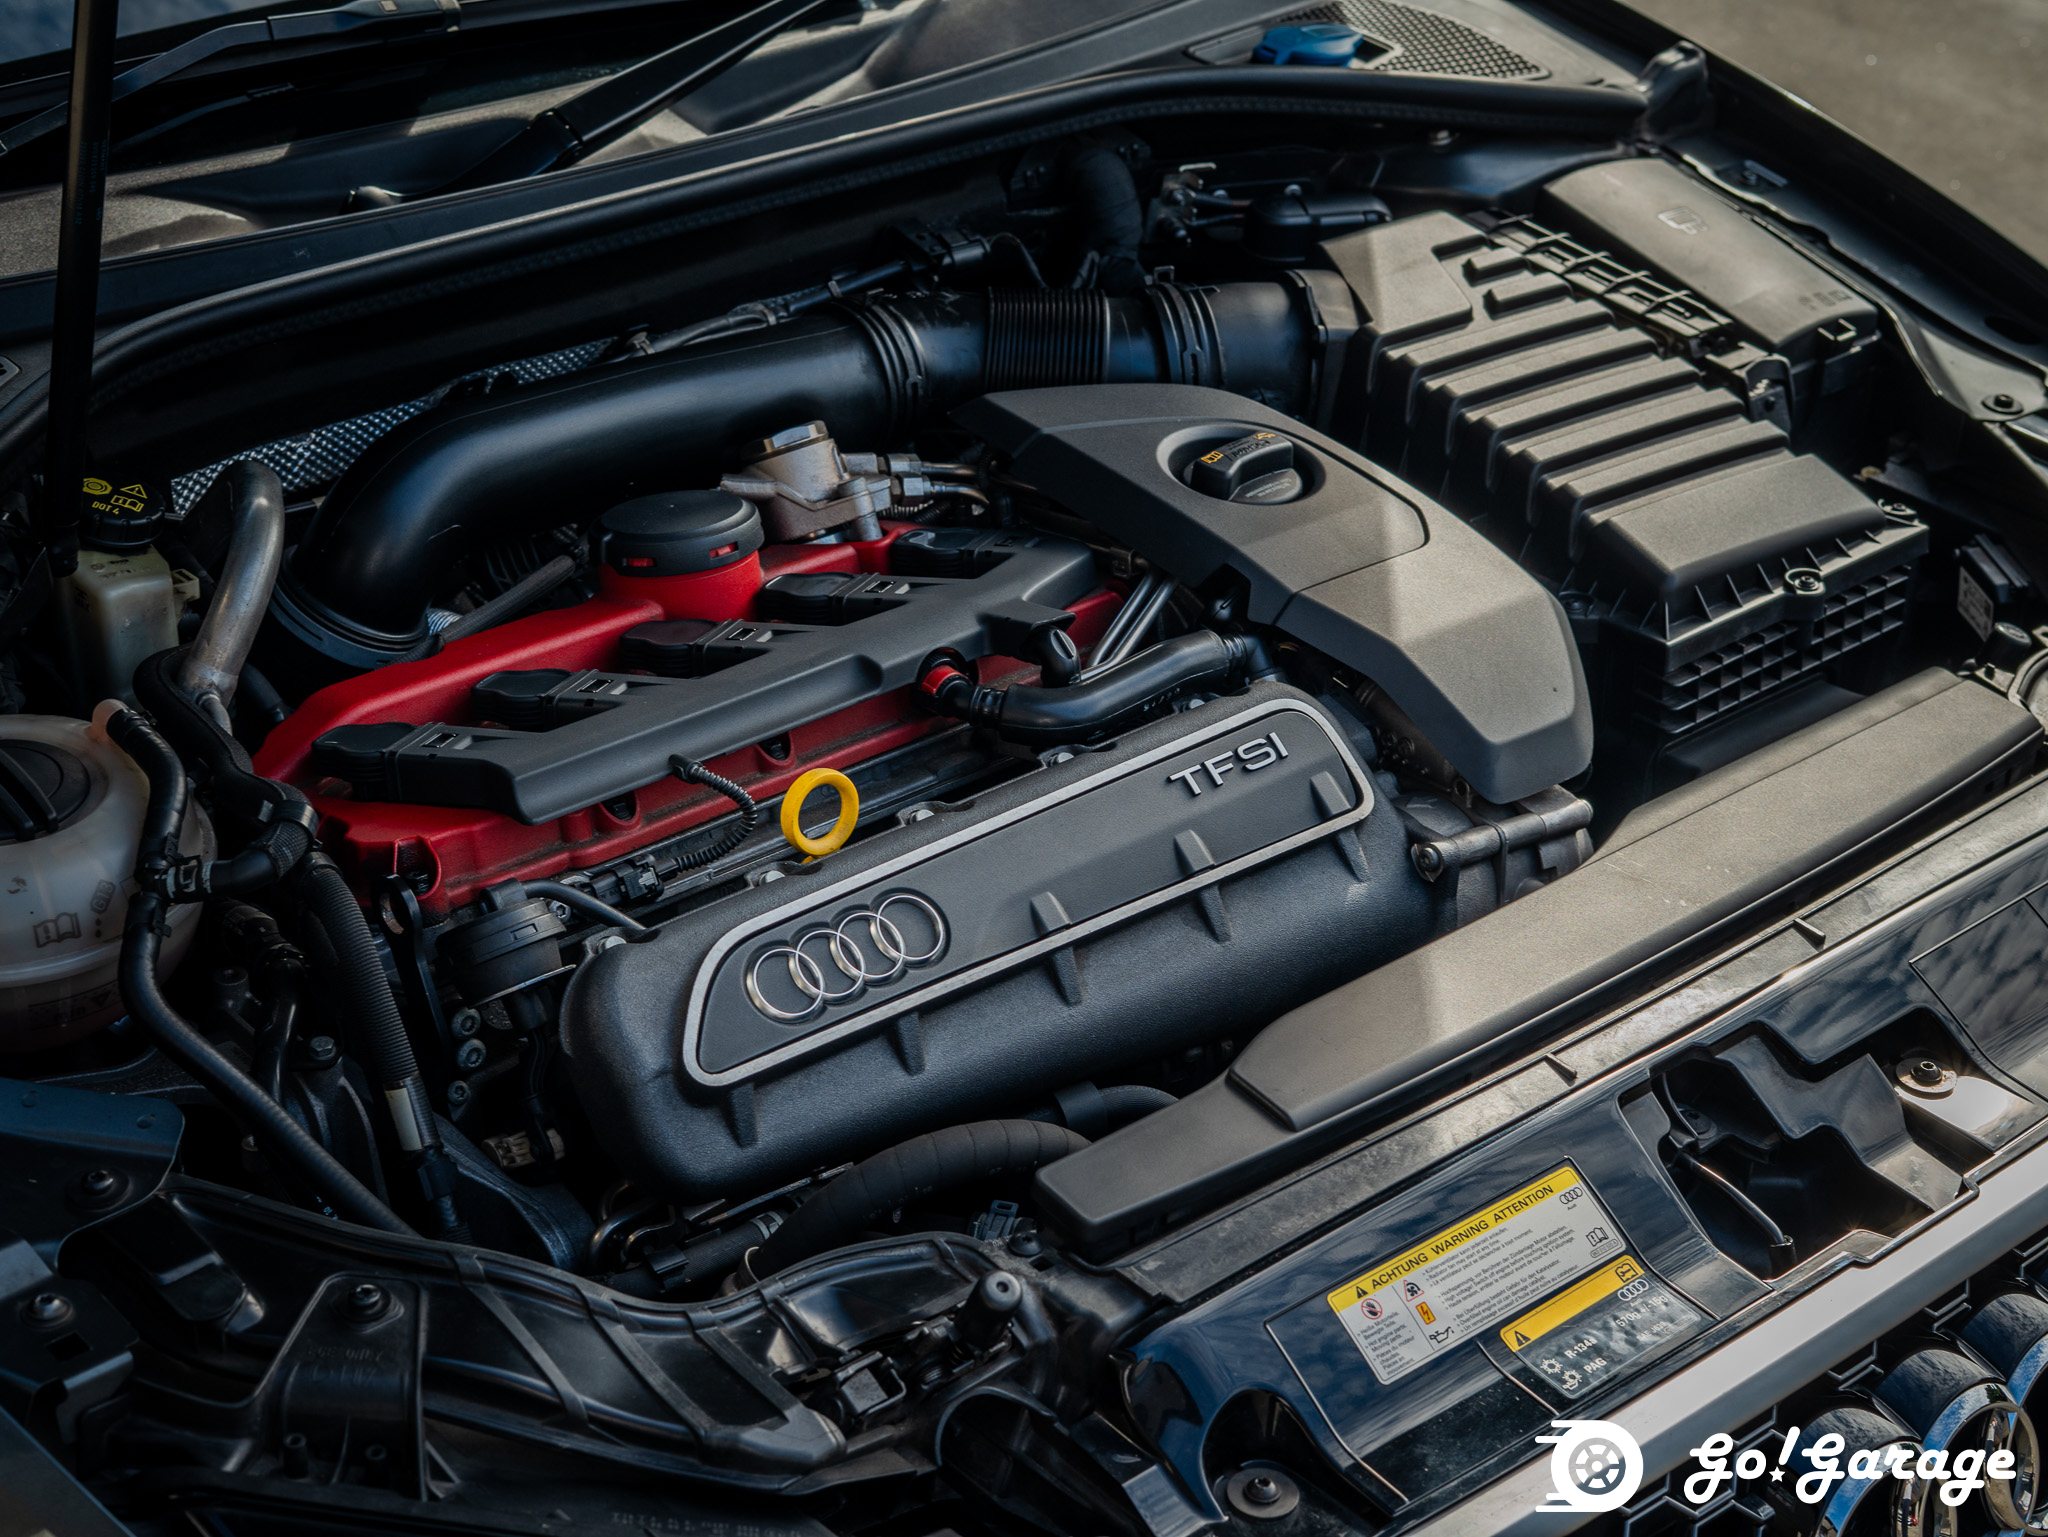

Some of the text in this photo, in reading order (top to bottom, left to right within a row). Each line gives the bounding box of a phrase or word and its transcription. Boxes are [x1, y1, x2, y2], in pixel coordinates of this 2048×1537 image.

[91, 501, 120, 515] DOT 4
[1167, 732, 1289, 796] TFSI
[1567, 1203, 1577, 1211] Audi
[1371, 1184, 1554, 1289] ACHTUNG WARNING ATTENTION
[1428, 1267, 1448, 1280] Radiator
[1465, 1251, 1476, 1260] start
[1488, 1239, 1500, 1247] time.
[1501, 1256, 1510, 1264] der
[1533, 1235, 1547, 1245] Motor
[1444, 1294, 1456, 1302] High
[1472, 1275, 1489, 1287] Switch
[1495, 1264, 1510, 1275] engine
[1509, 1256, 1525, 1267] before
[1523, 1246, 1544, 1259] touching
[1542, 1237, 1559, 1249] ignition
[1462, 1261, 1473, 1270] peut
[1448, 1298, 1462, 1308] Haute
[1498, 1269, 1514, 1280] moteur
[1514, 1262, 1527, 1272] avant
[1531, 1250, 1549, 1262] toucher
[1488, 1288, 1507, 1301] besteht
[1505, 1281, 1521, 1292] Gefahr
[1527, 1272, 1537, 1280] den
[1529, 1285, 1540, 1295] peut
[1459, 1310, 1482, 1326] Overfilled
[1481, 1302, 1497, 1314] engine
[1502, 1294, 1511, 1302] can
[1511, 1284, 1529, 1297] damage
[1629, 1297, 1644, 1307] Audi
[1371, 1340, 1390, 1352] Moving
[1377, 1330, 1394, 1343] engine
[1398, 1335, 1415, 1347] moteur
[1564, 1337, 1598, 1359] R-134a
[1615, 1311, 1642, 1327] 570g
[1583, 1358, 1608, 1374] PAG
